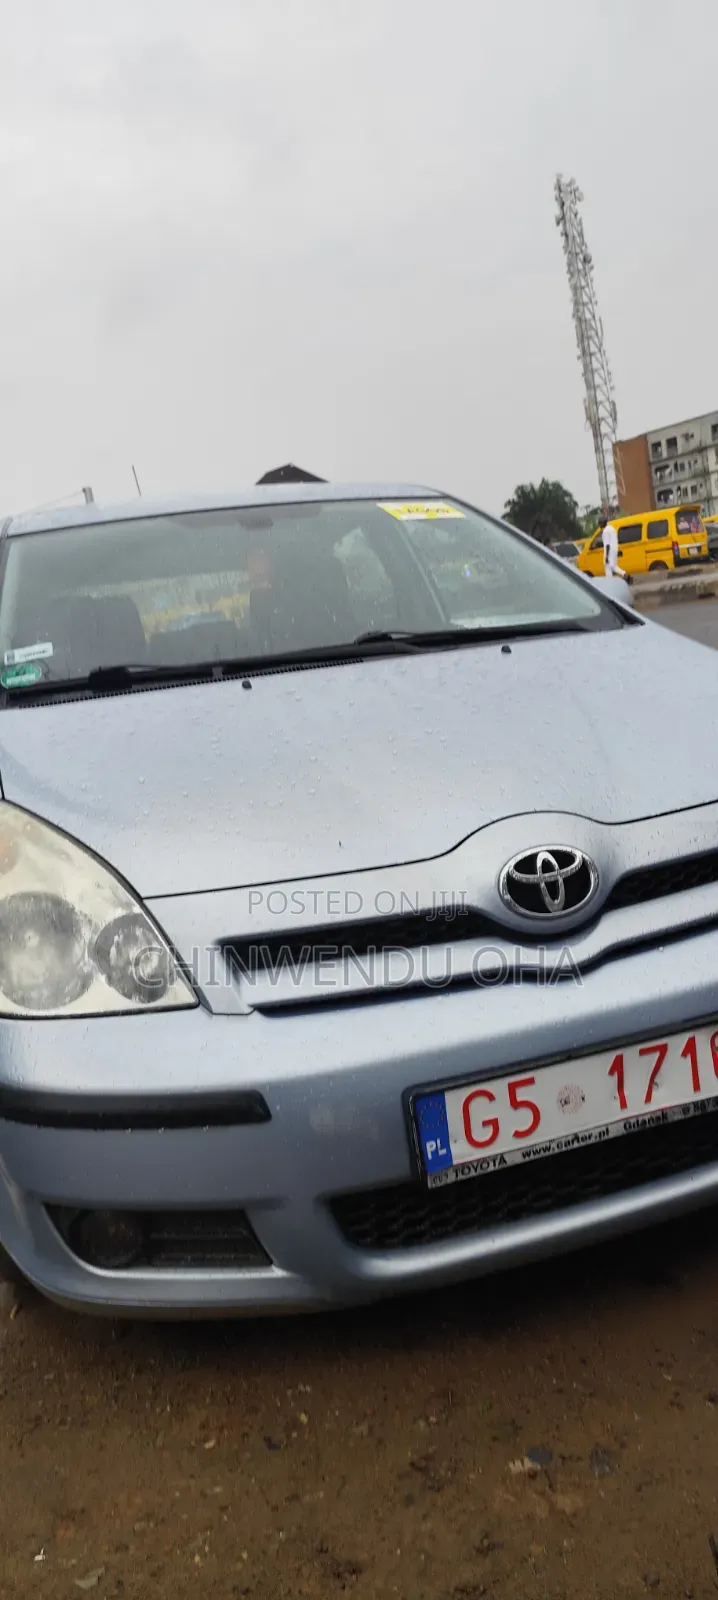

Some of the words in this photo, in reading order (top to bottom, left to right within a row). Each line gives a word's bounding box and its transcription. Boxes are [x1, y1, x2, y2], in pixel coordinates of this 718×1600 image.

[461, 1076, 541, 1149] G5
[426, 1138, 447, 1160] PL
[453, 1153, 508, 1179] TOYOTA
[522, 1127, 609, 1159] www.carter.pl
